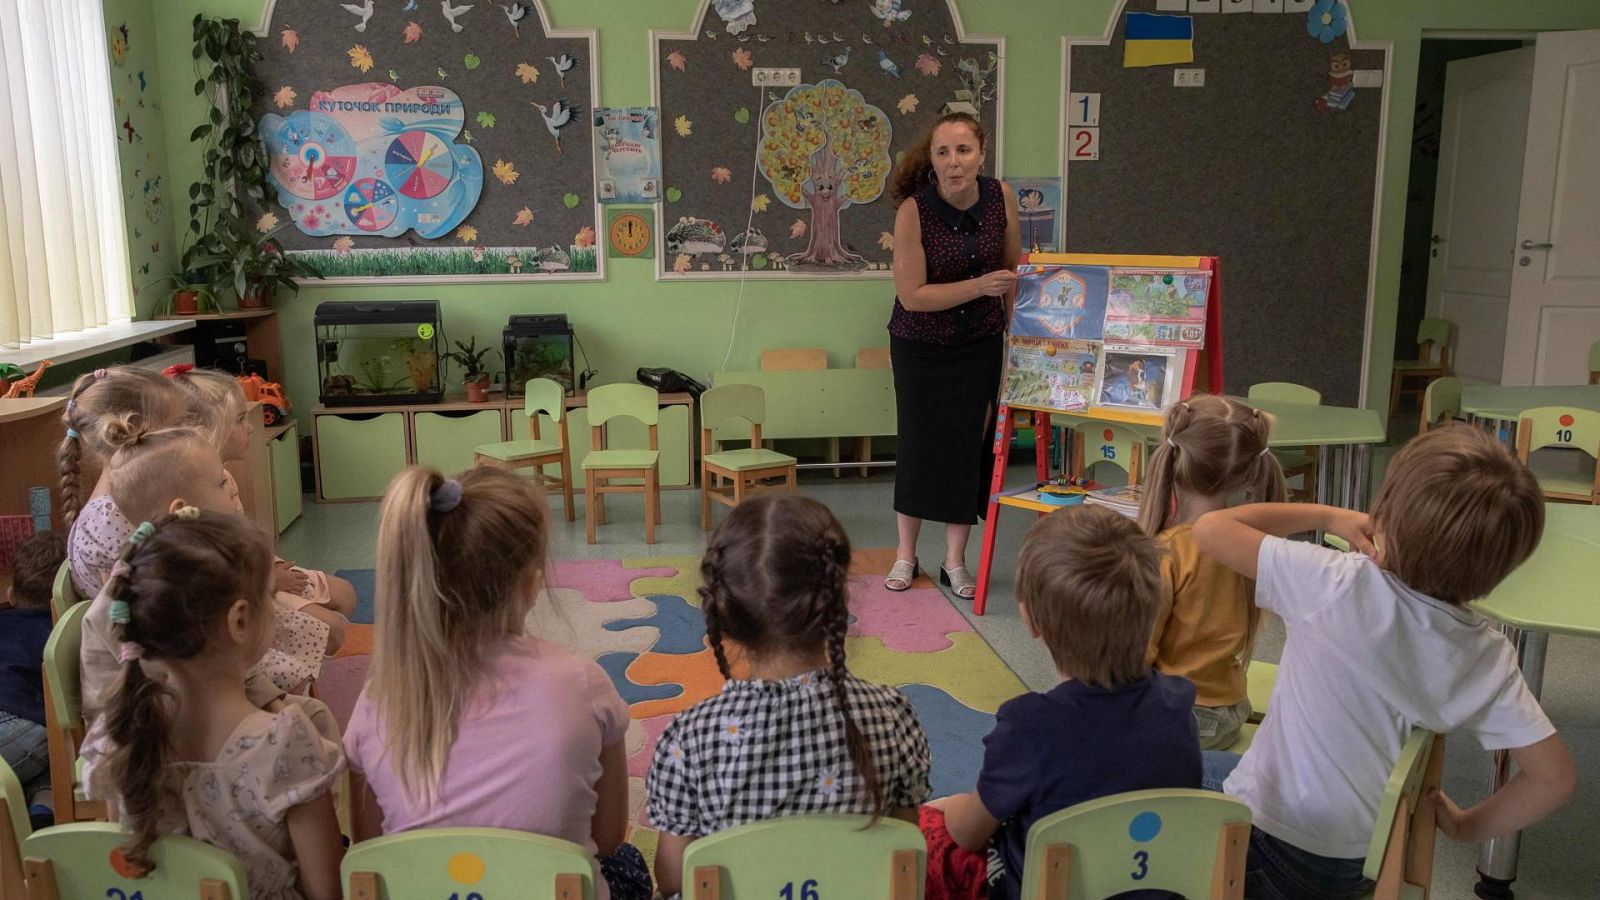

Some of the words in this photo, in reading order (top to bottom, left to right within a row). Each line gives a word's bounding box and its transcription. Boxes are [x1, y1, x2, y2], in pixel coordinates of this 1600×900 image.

[319, 101, 382, 113] КУТОЧОК
[385, 102, 451, 116] ПРИРОДИ
[1079, 95, 1089, 122] 1
[1075, 130, 1092, 157] 2
[1556, 430, 1572, 442] 10
[1101, 445, 1116, 459] 15
[1131, 851, 1149, 881] 3
[779, 879, 819, 900] 16
